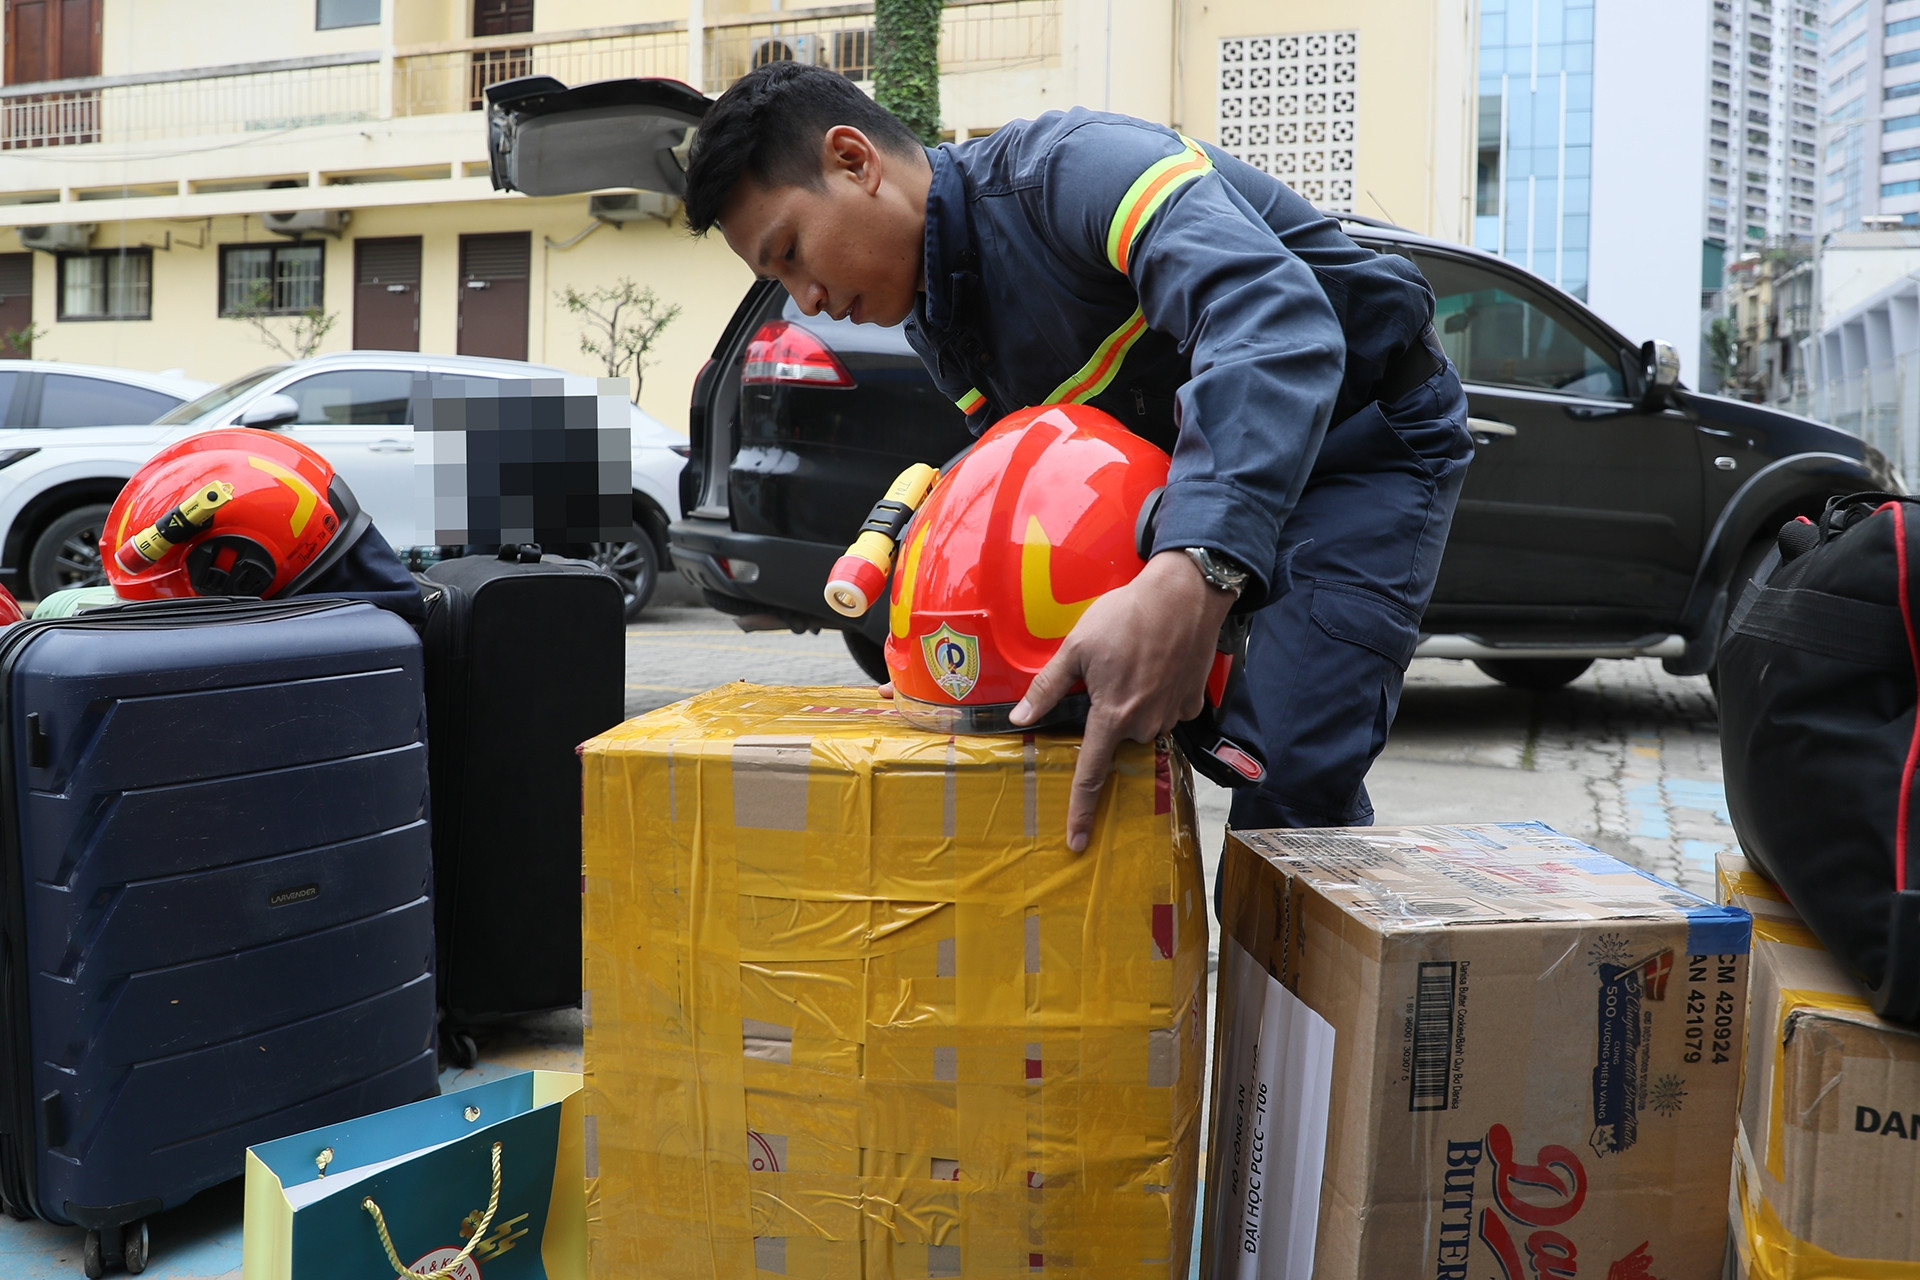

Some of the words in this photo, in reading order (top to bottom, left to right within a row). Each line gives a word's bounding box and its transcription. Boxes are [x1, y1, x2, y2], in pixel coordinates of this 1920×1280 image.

[271, 887, 316, 904] LARVENDER
[1459, 961, 1470, 985] Danisa
[1458, 987, 1468, 1007] Butter
[1605, 986, 1618, 1017] 500
[1404, 1016, 1412, 1043] 96001
[1601, 1020, 1613, 1058] VƯƠNG
[1684, 990, 1706, 1064] 421079
[1712, 991, 1735, 1064] 420924
[1402, 1047, 1411, 1072] 30307
[1452, 1058, 1465, 1072] Quy
[1236, 1083, 1246, 1111] AN
[1451, 1086, 1462, 1110] Danisa
[1233, 1114, 1244, 1166] CÔNG
[1250, 1127, 1265, 1175] PCCC
[1246, 1180, 1264, 1217] HỌC
[1243, 1221, 1261, 1255] ĐẠI
